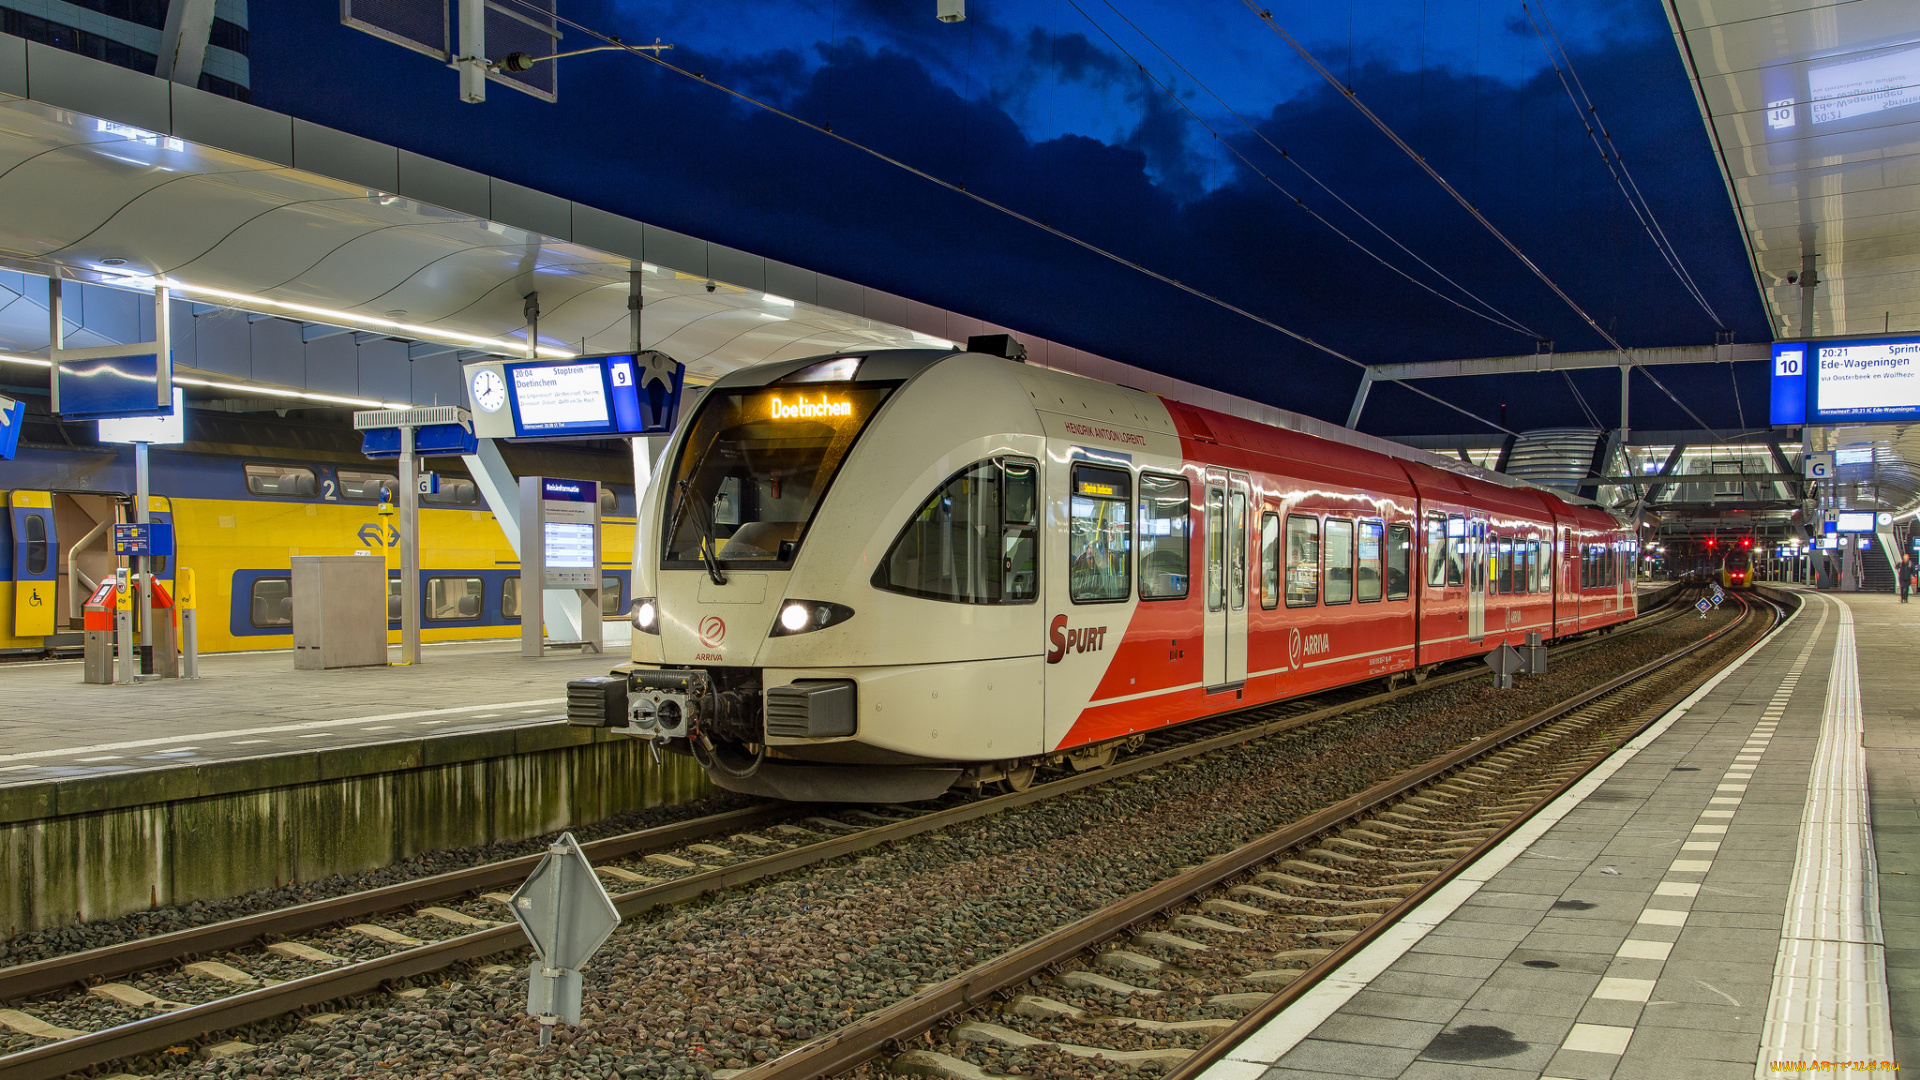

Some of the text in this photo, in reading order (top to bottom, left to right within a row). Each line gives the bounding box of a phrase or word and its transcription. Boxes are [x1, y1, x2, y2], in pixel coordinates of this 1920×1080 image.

[1822, 348, 1848, 358] 20:21
[1889, 345, 1920, 356] Sprint
[1780, 360, 1798, 373] 10
[1821, 357, 1910, 370] Ede-Wageningen
[515, 369, 533, 378] 20:04
[553, 367, 584, 376] Stoptrein
[1833, 373, 1871, 381] Oosterbeek
[1883, 371, 1915, 379] Wolfheze
[516, 378, 557, 388] Doetinchem
[618, 372, 625, 384] 9
[771, 395, 851, 419] Doetinchem
[1064, 421, 1146, 446] HENDRIK ANTOON LORENTZ
[1812, 463, 1825, 476] G
[323, 480, 337, 500] 2
[419, 481, 427, 491] G
[1829, 513, 1836, 521] H
[1047, 614, 1107, 664] SPURT
[1303, 633, 1329, 656] ARRIVA
[695, 653, 723, 661] ARRIVA
